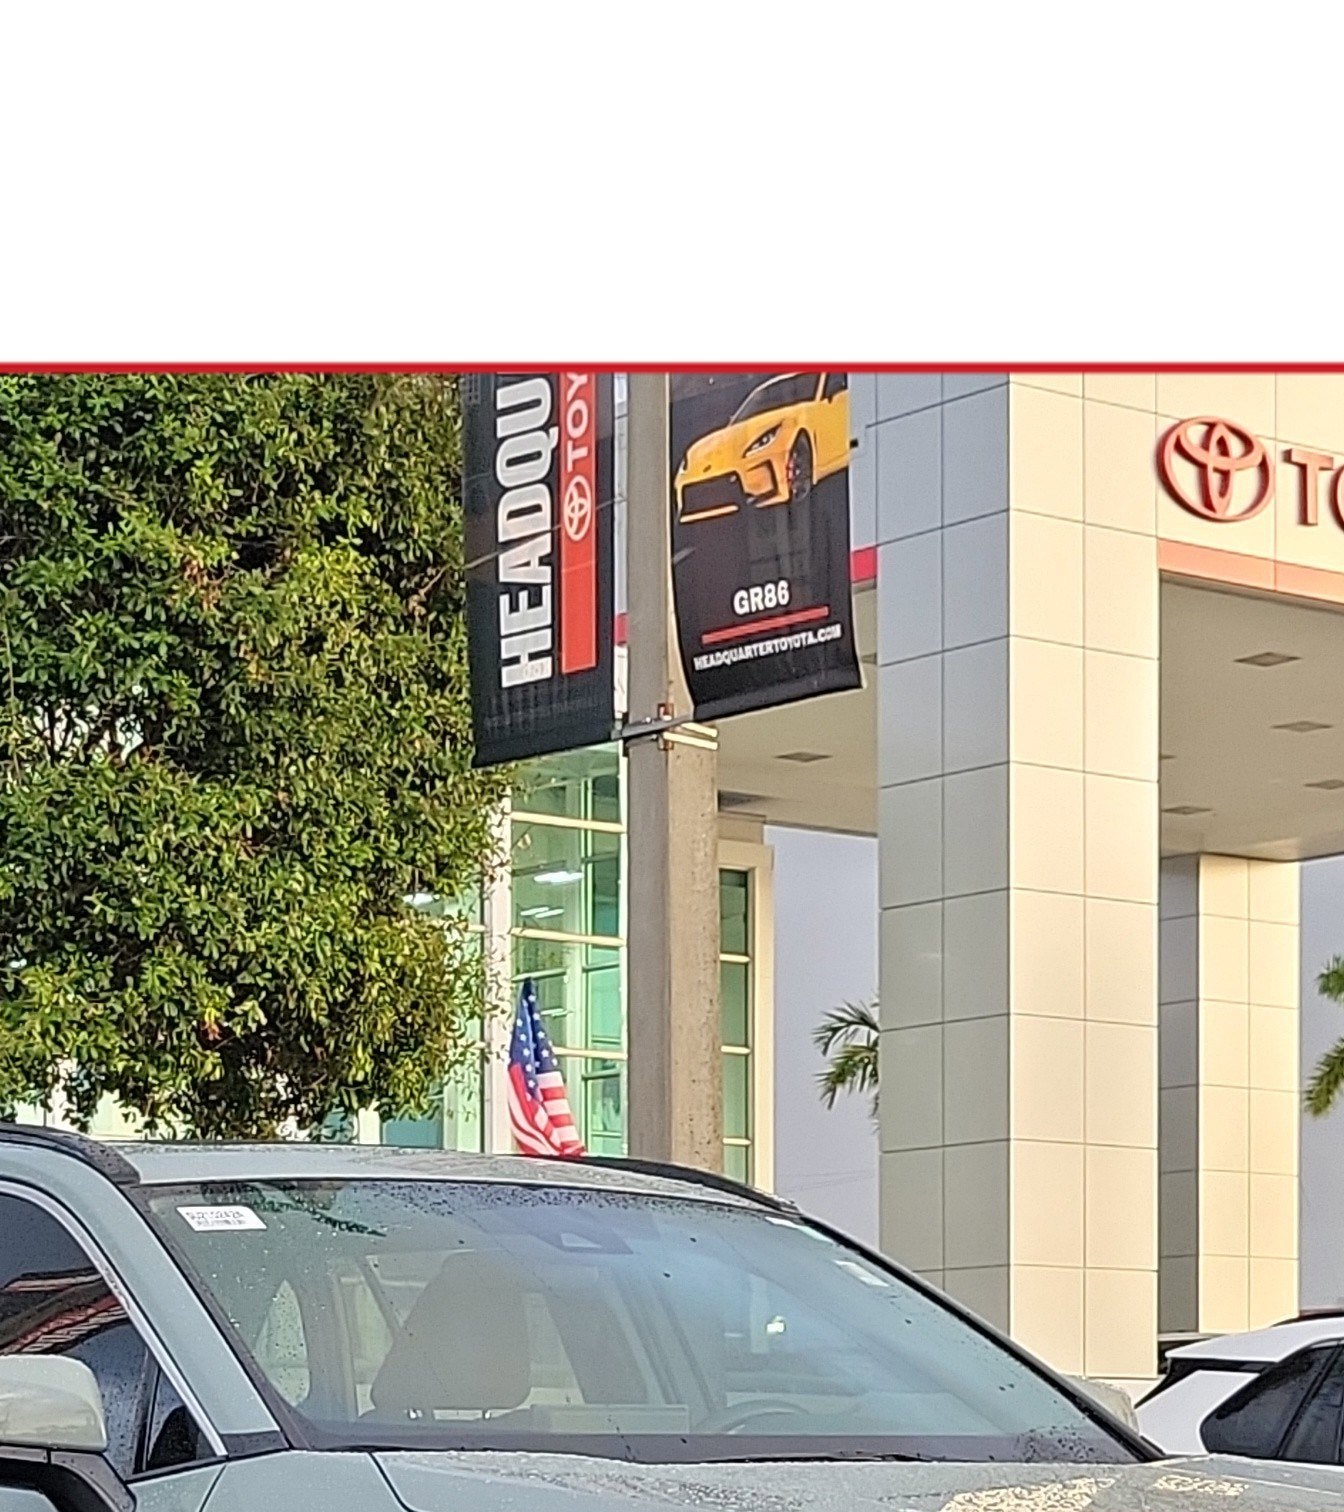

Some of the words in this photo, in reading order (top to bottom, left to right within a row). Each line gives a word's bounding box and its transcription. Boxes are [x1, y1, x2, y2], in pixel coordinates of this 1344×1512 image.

[496, 372, 559, 688] HEADQU
[733, 580, 790, 615] GR86
[693, 623, 842, 671] HEADQUARTERTOYOTA.COM
